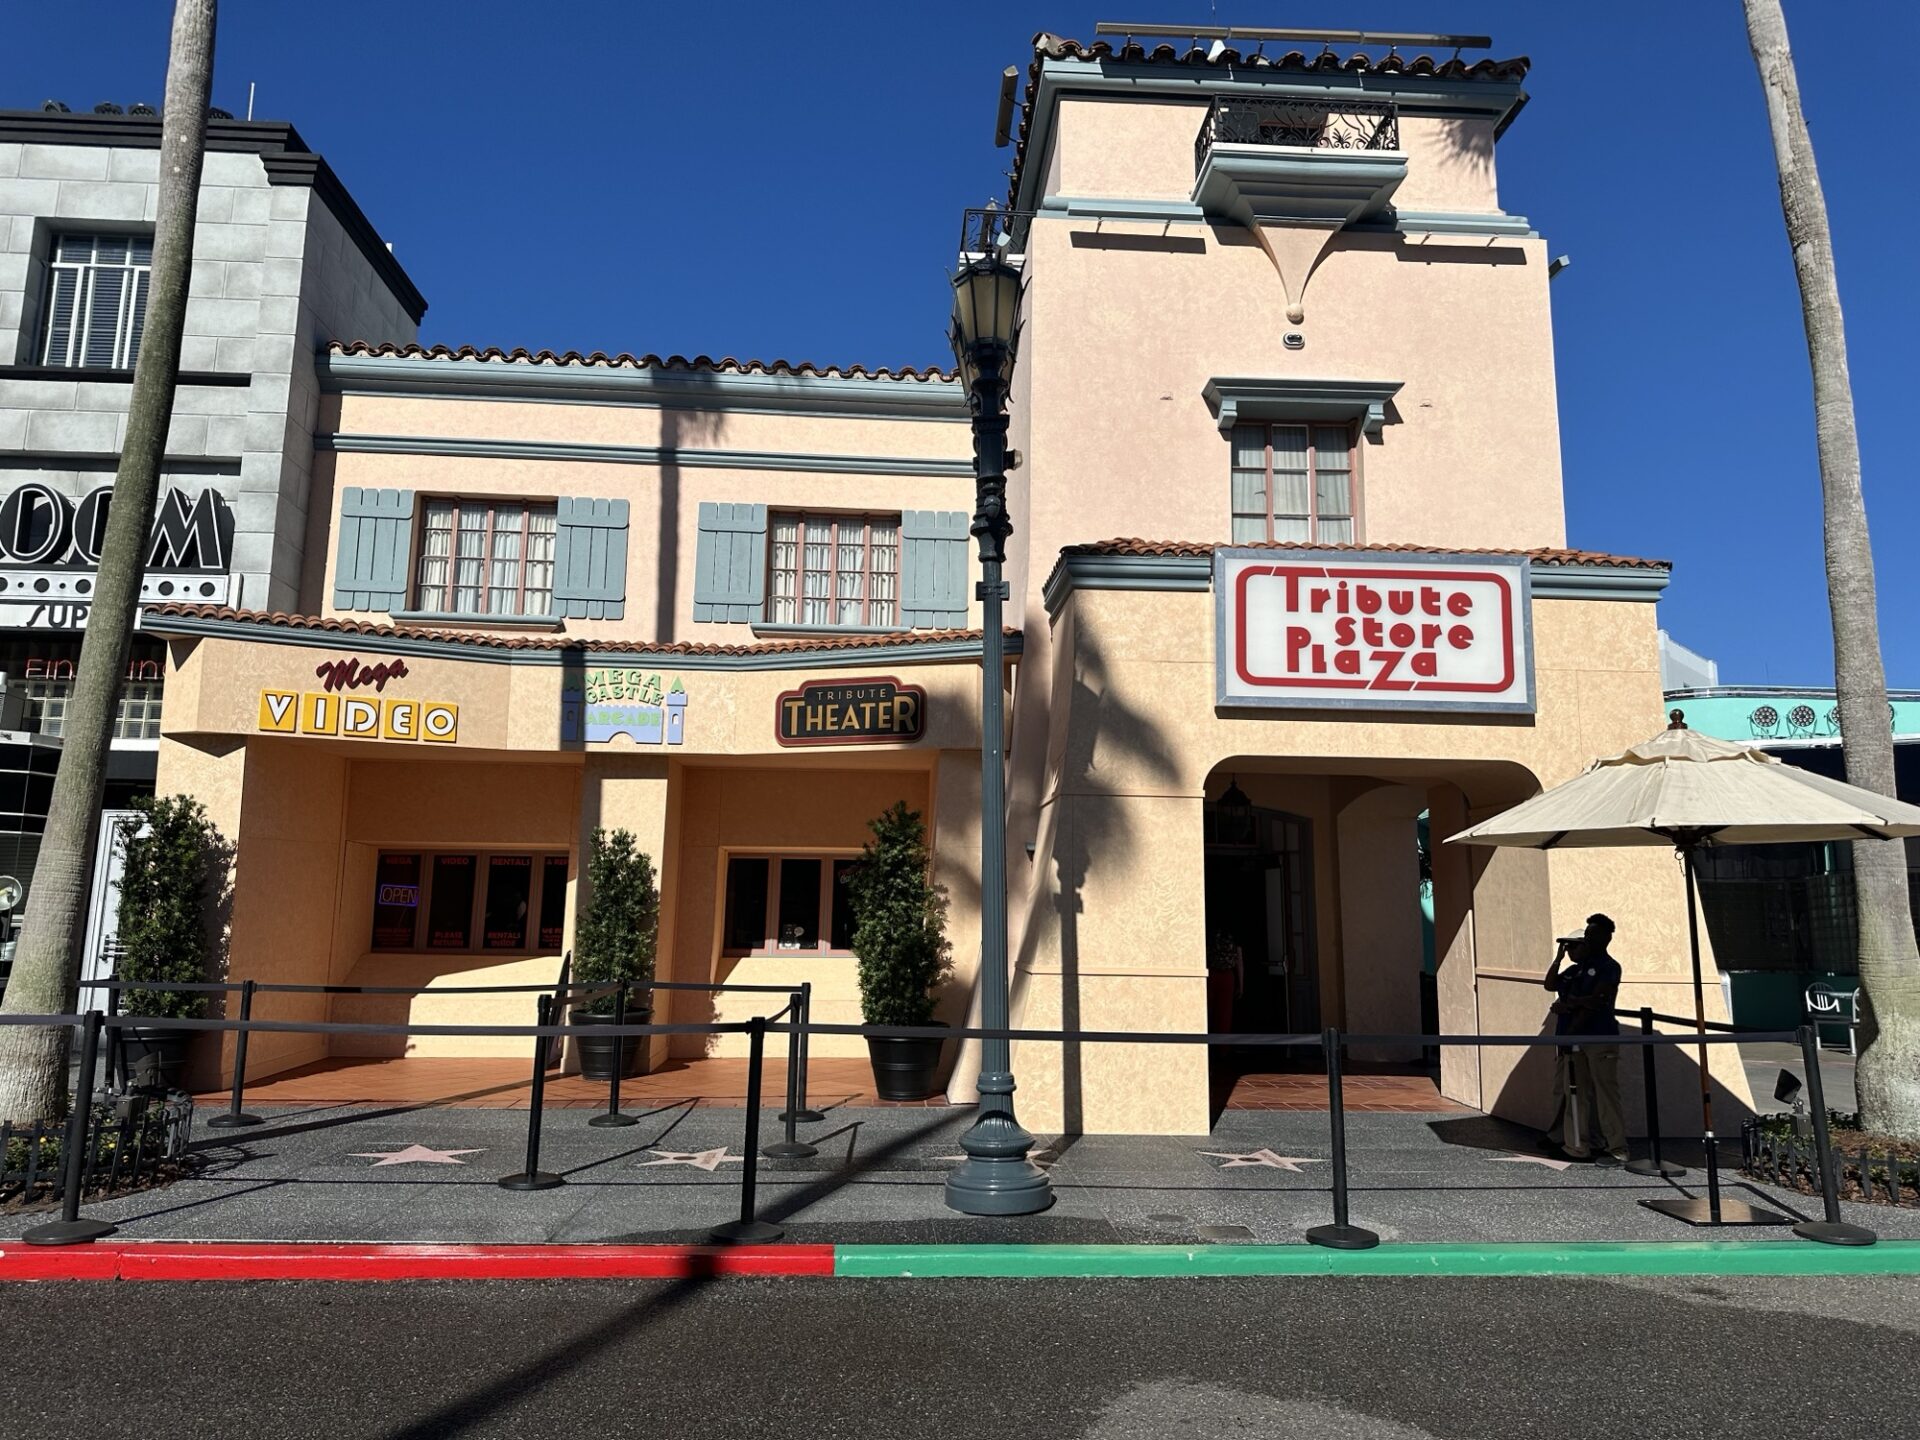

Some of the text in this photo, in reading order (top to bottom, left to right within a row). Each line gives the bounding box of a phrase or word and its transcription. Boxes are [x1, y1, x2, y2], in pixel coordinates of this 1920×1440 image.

[0, 483, 226, 569] OOM
[1271, 566, 1474, 618] Tribute
[26, 603, 89, 629] SUP
[1334, 616, 1475, 650] Store
[316, 657, 409, 693] Mega
[583, 669, 662, 691] MEGA
[585, 685, 664, 706] CASTLE
[816, 688, 887, 701] TRIBUTE
[264, 693, 456, 736] VIDEO
[586, 710, 661, 726] ARCADE
[784, 695, 916, 736] THEATER
[382, 887, 417, 905] OPEN
